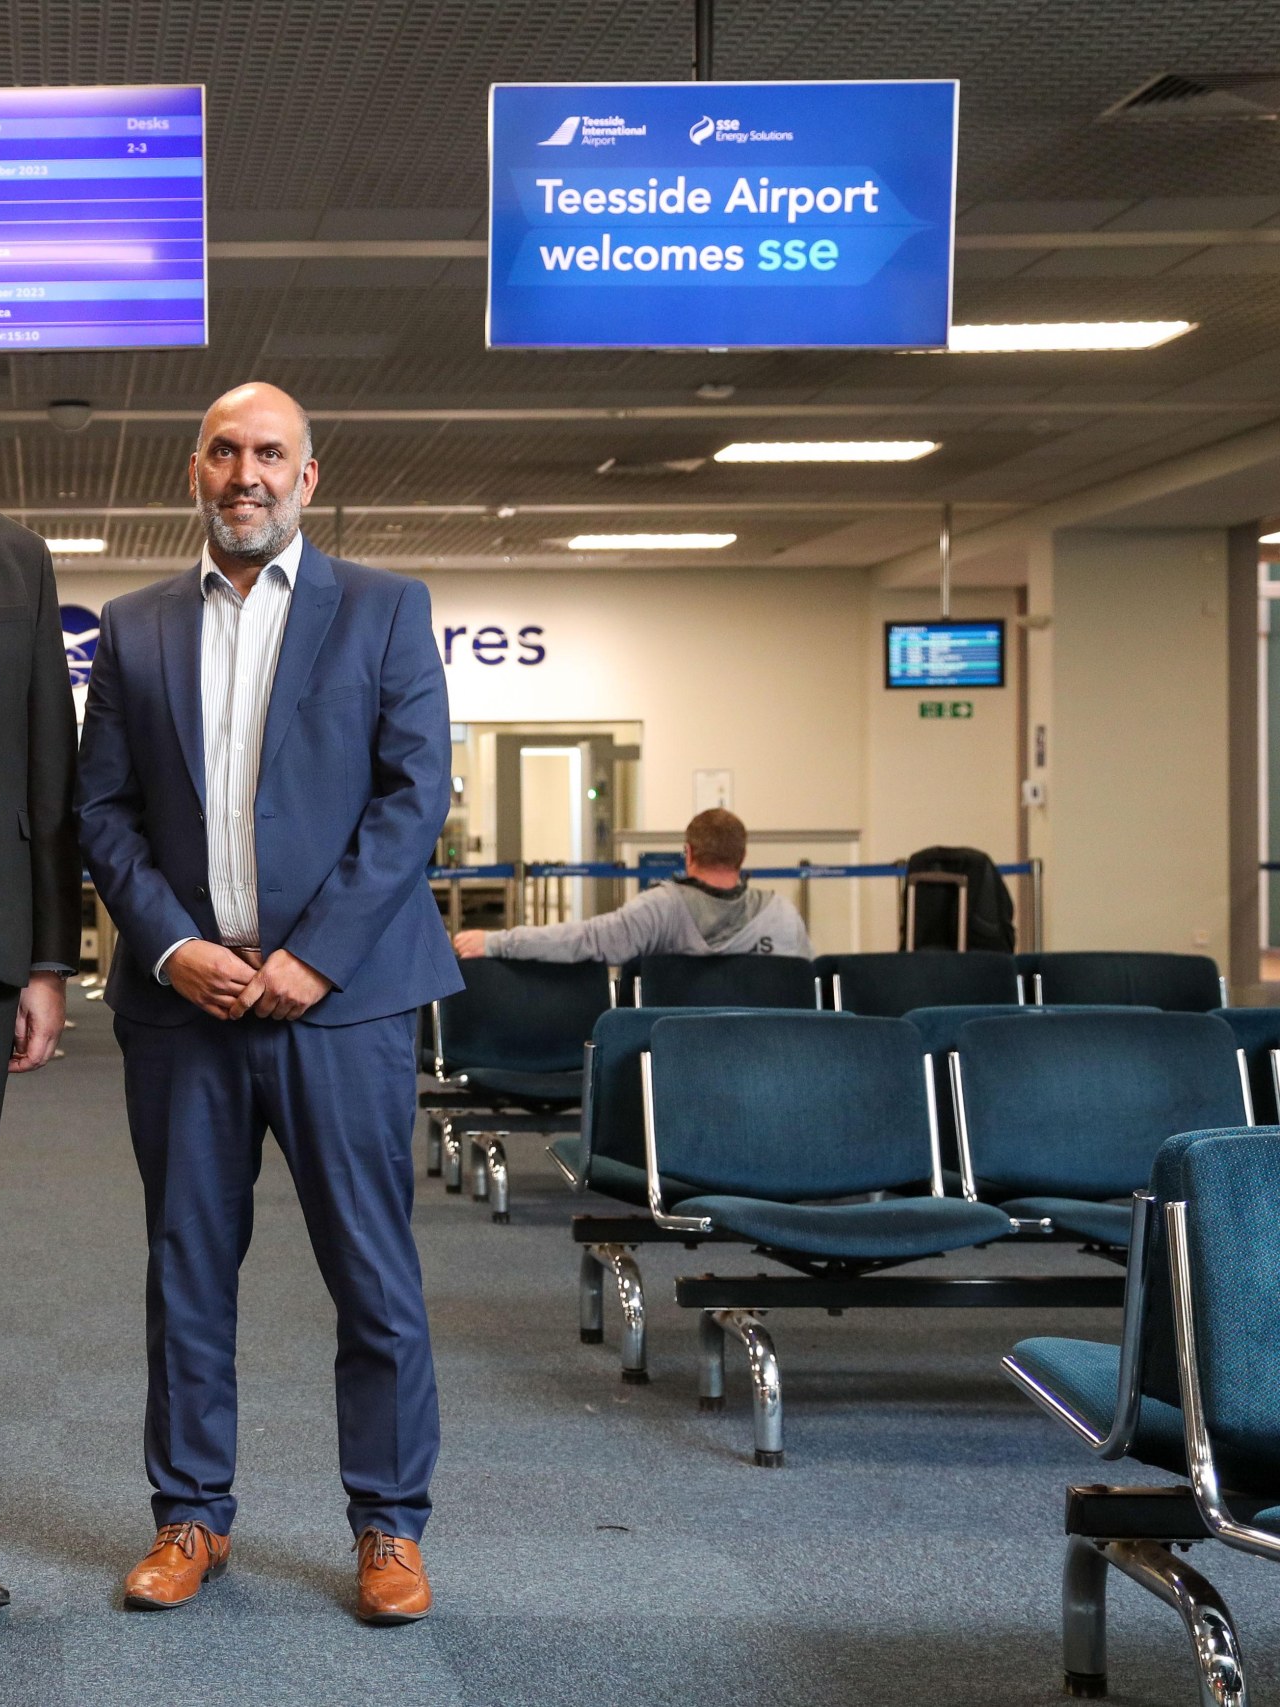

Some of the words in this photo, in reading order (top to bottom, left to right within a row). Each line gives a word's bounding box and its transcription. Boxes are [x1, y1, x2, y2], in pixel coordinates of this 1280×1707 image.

[127, 118, 169, 131] Desks
[581, 116, 625, 126] Teesside
[716, 119, 740, 131] sse
[581, 126, 647, 136] International
[715, 131, 749, 143] Energy
[749, 131, 794, 142] Solutions
[581, 136, 616, 148] Airport
[127, 143, 148, 154] 2-3
[18, 165, 49, 177] 2023
[536, 175, 713, 215] Teesside
[723, 176, 880, 224] Airport
[539, 233, 745, 272] welcomes
[757, 237, 840, 272] sse
[15, 287, 46, 299] 2023
